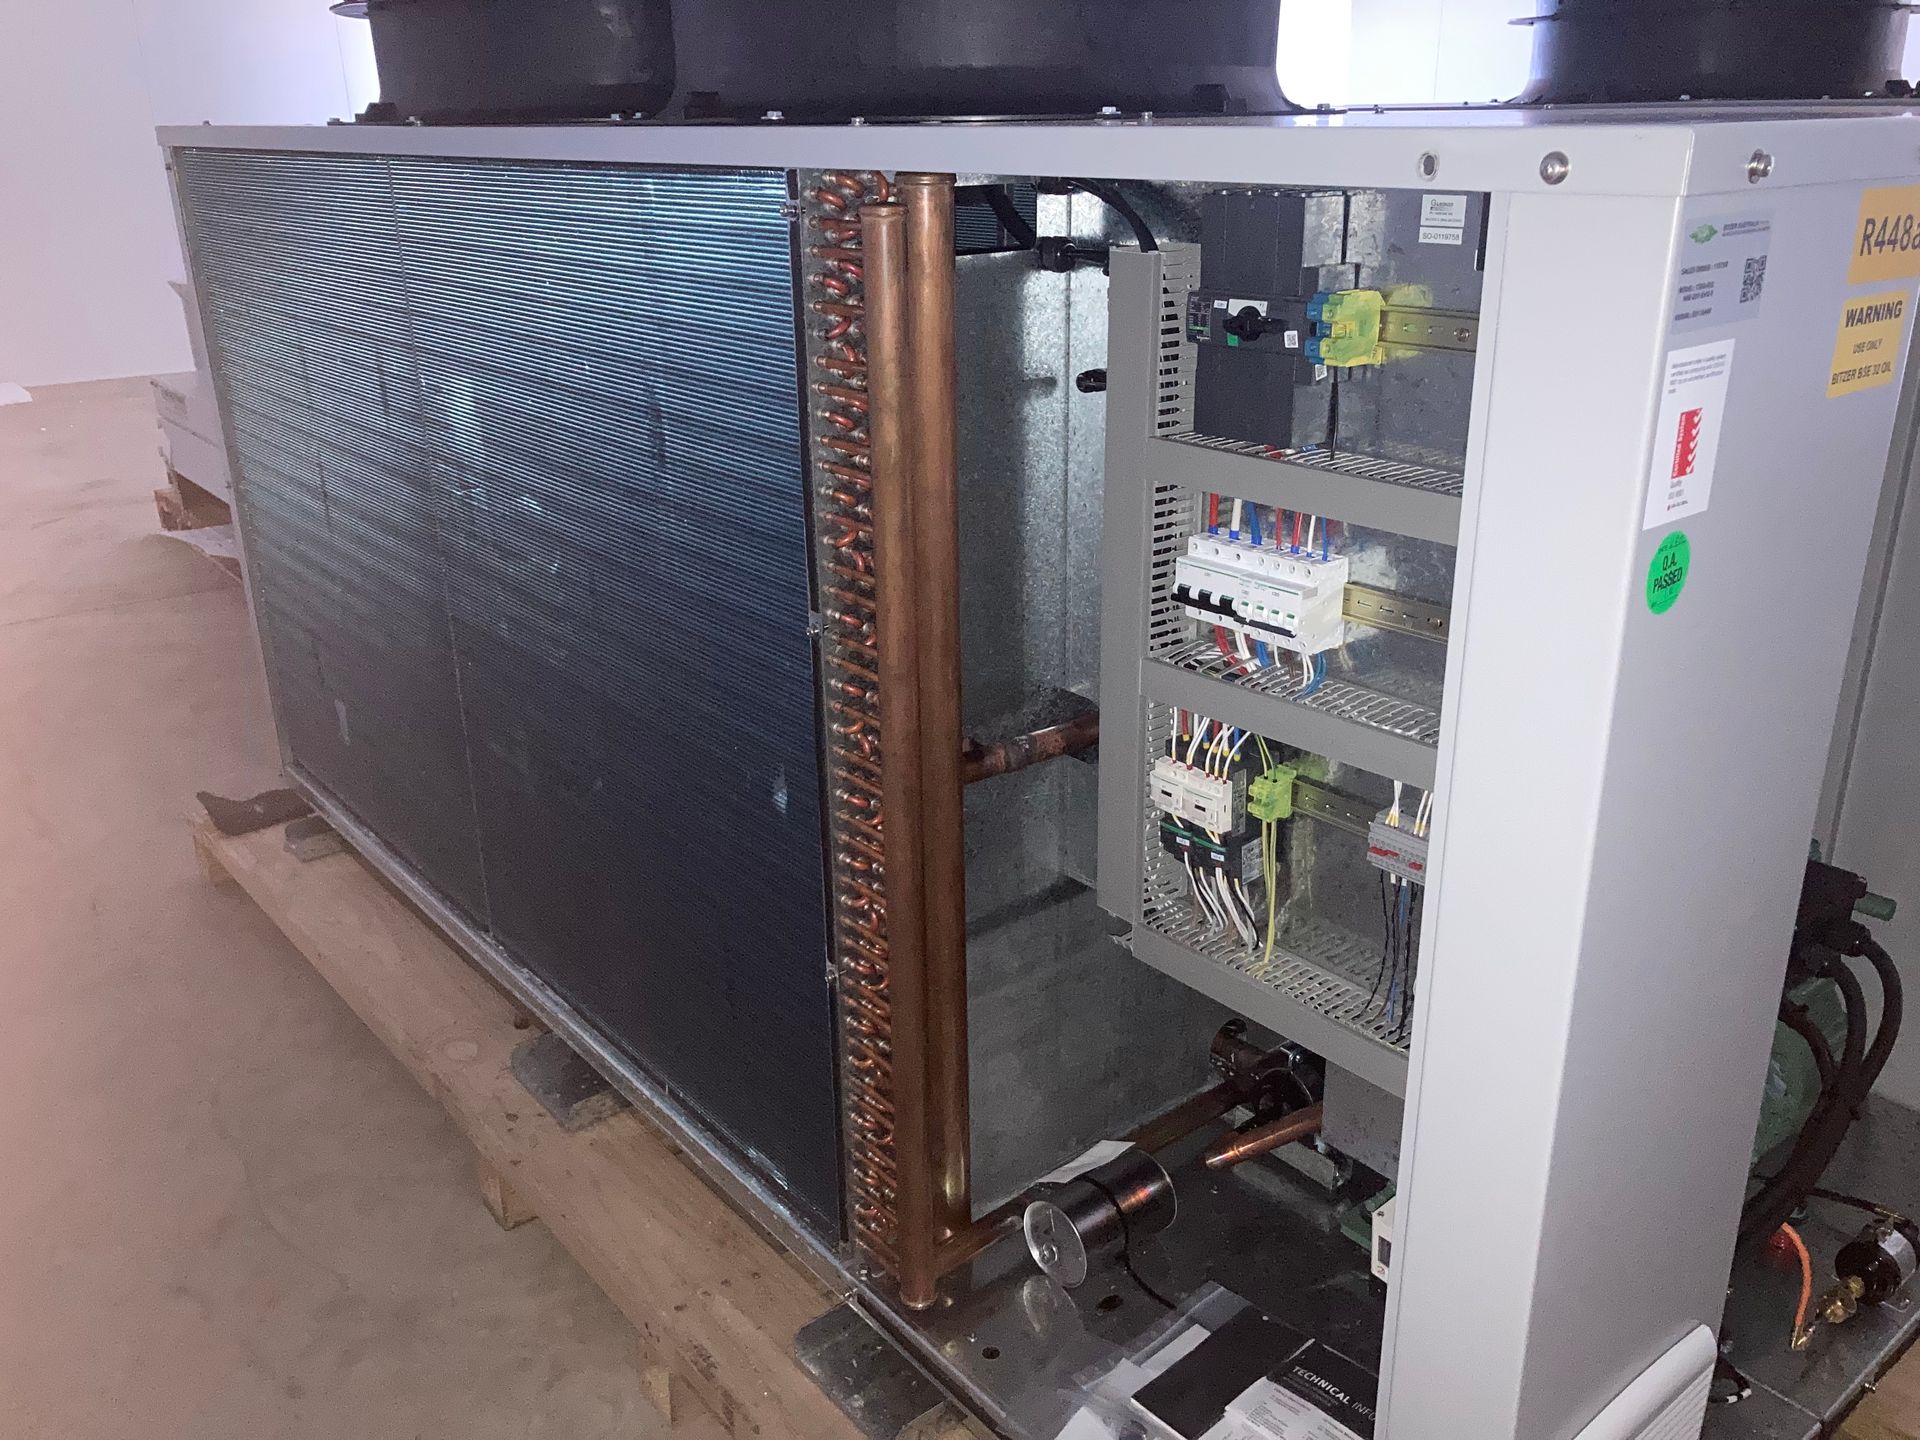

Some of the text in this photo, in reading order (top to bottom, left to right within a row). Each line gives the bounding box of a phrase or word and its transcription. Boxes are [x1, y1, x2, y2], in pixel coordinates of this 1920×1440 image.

[1845, 300, 1903, 328] WARNING
[1853, 338, 1883, 354] USE ONLY
[1831, 369, 1857, 385] BITZER
[1857, 365, 1873, 379] BSE
[1652, 566, 1683, 594] PASSED
[1292, 1365, 1351, 1405] TECHNICAL
